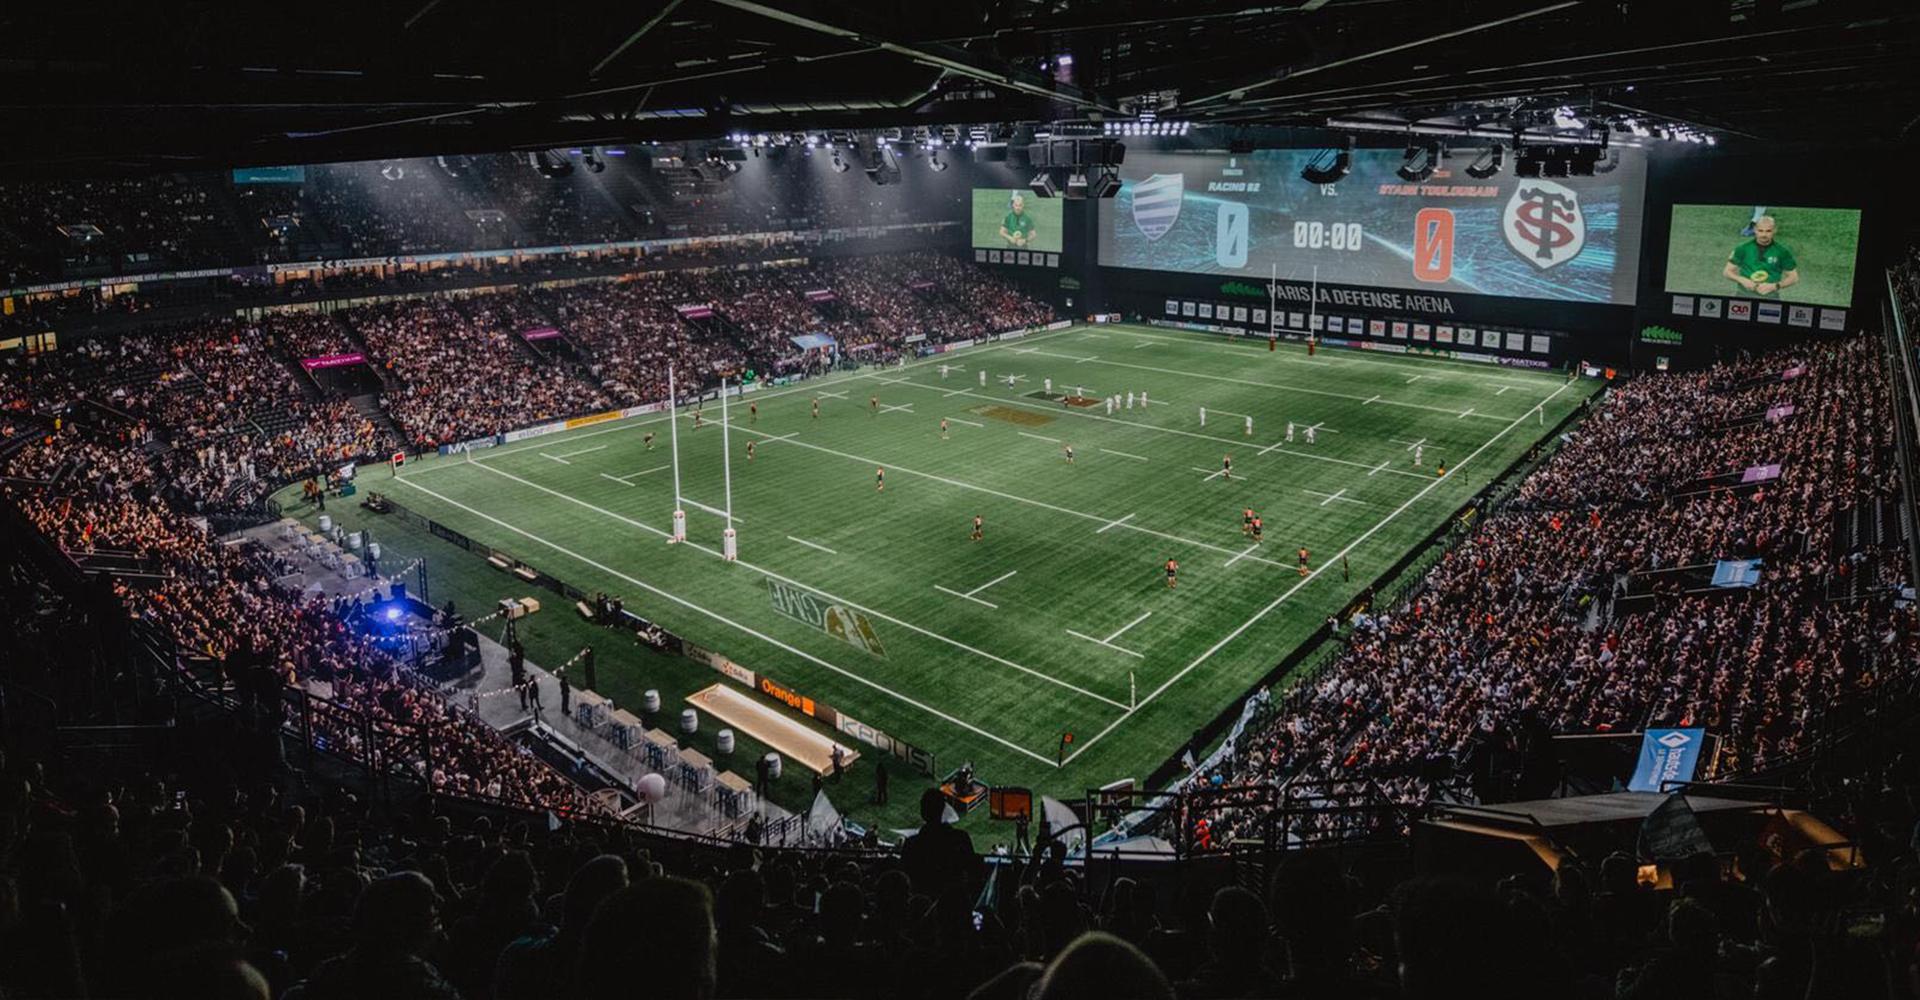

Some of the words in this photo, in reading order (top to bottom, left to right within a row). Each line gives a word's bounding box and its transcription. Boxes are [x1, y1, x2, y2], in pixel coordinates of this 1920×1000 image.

[1208, 182, 1245, 192] RACING
[1320, 184, 1338, 196] VS.
[1216, 202, 1249, 268] 0
[1294, 221, 1363, 251] 00:00
[1413, 207, 1455, 283] 0
[1266, 284, 1311, 302] PARIS
[1314, 288, 1331, 304] LA
[1332, 289, 1402, 310] DEFENSE
[1405, 295, 1455, 314] ARENA
[762, 678, 801, 708] Orange
